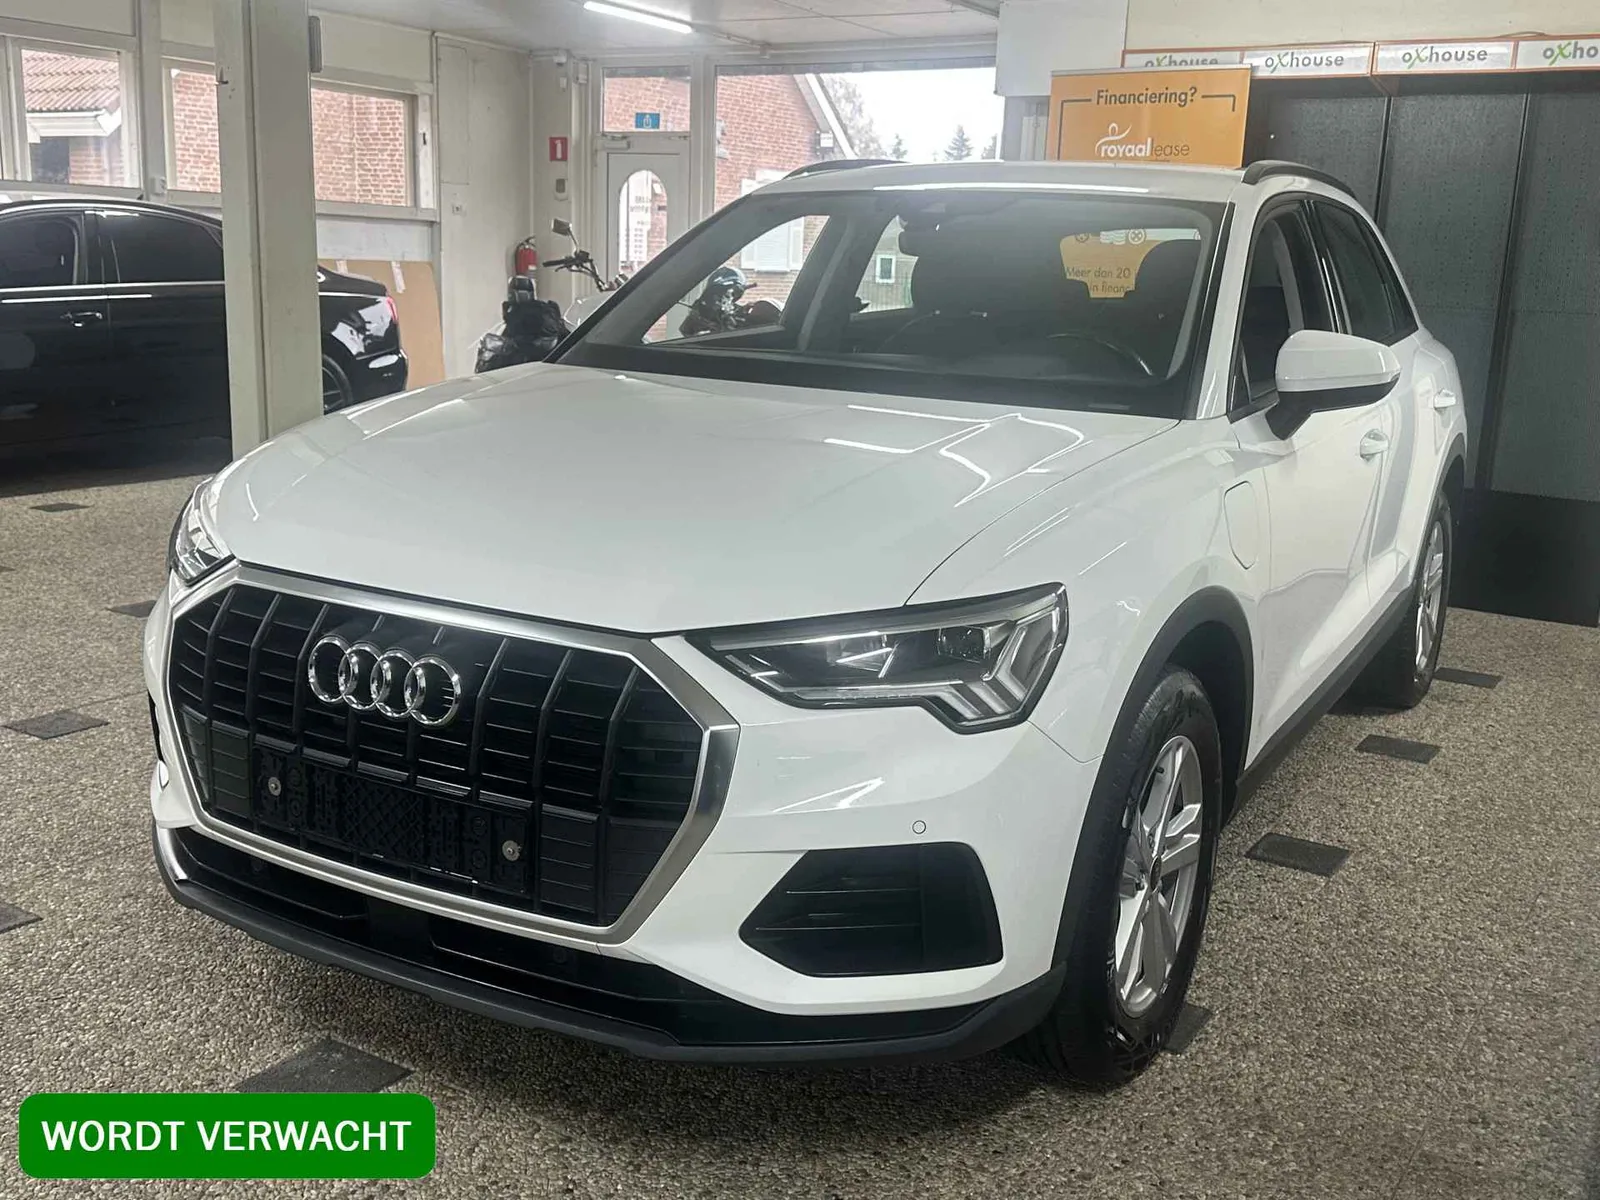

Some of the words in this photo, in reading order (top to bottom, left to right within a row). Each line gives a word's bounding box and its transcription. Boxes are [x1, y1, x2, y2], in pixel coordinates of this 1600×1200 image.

[1096, 86, 1197, 107] Financiering?
[1094, 267, 1112, 277] dan
[1116, 267, 1131, 279] 20
